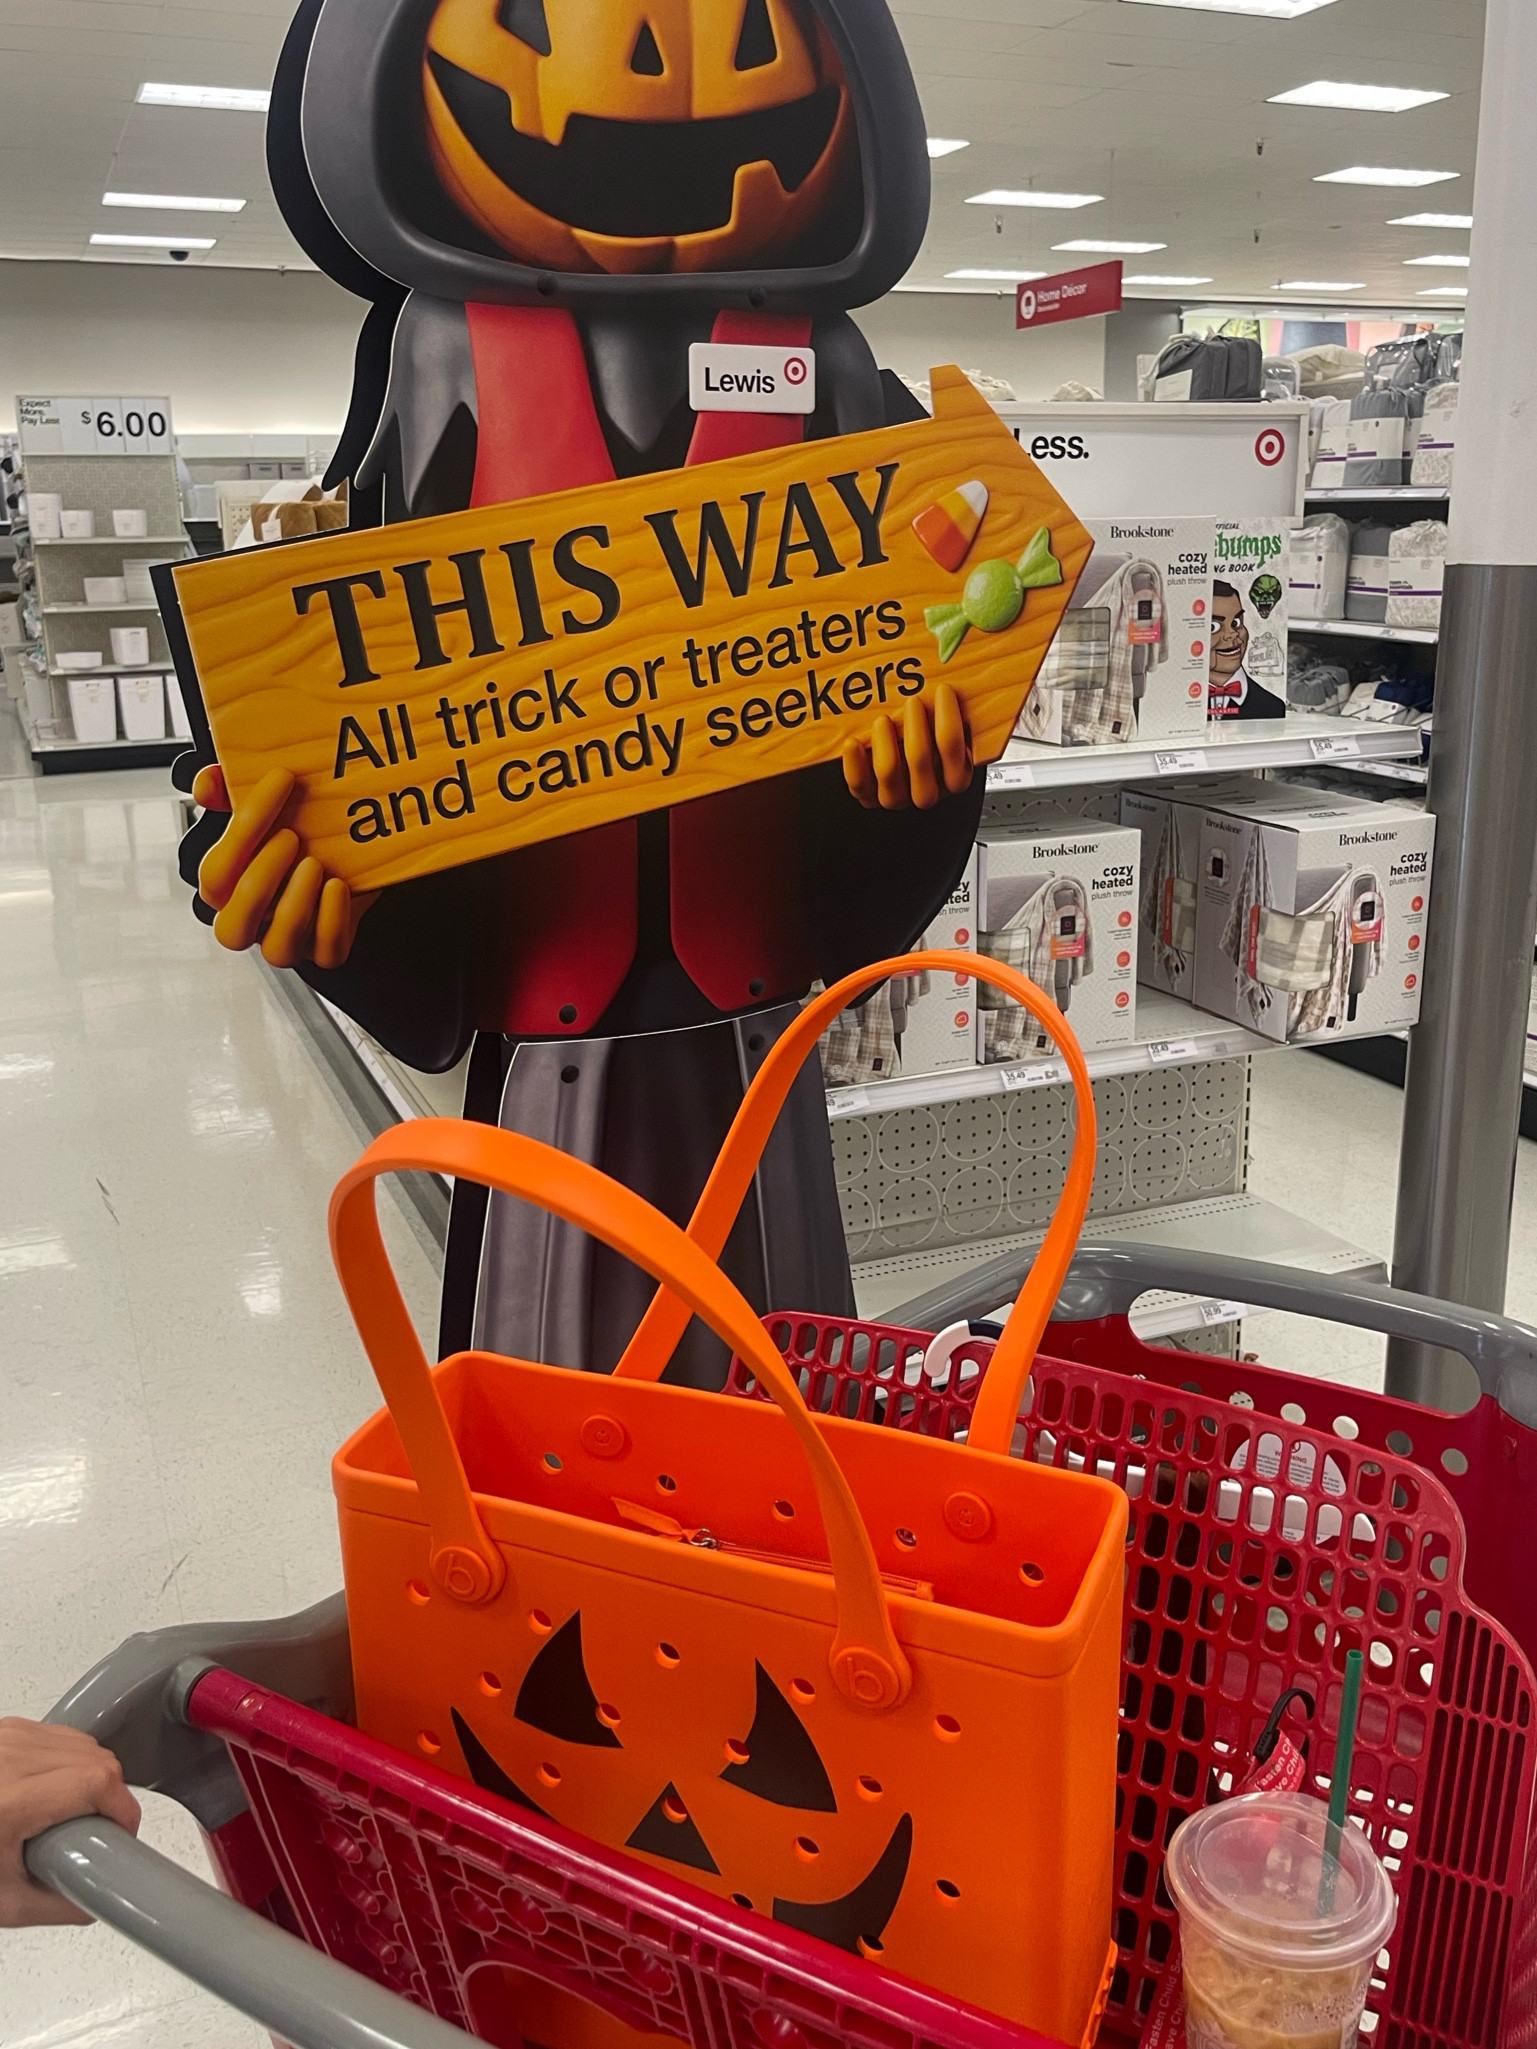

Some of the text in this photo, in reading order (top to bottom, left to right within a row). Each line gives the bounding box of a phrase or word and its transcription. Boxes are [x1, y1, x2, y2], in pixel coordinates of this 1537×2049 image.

[705, 366, 775, 394] Lewis
[1110, 525, 1175, 539] Brookstone
[1215, 531, 1282, 569] bumps
[1178, 552, 1208, 564] cozy
[291, 462, 901, 689] THIS WAY
[1168, 563, 1208, 575] heated
[1228, 563, 1256, 573] BOOK
[1167, 578, 1187, 586] plush
[333, 599, 908, 780] All trick or treaters
[346, 655, 927, 845] and candy seekers
[1125, 798, 1158, 813] Brookstone
[1205, 816, 1243, 835] Brookstone
[1339, 831, 1398, 847] Brookstone
[1032, 843, 1099, 859] Brookstone
[1400, 851, 1428, 864] cozy
[1103, 865, 1134, 877] cozy
[1390, 861, 1427, 877] heated
[954, 880, 970, 892] zy
[1092, 875, 1133, 890] heated
[1388, 875, 1427, 887] plush throw
[945, 892, 970, 905] ted
[1091, 889, 1134, 901] plush throw
[949, 906, 970, 914] throw
[1256, 1756, 1286, 1787] asten
[1159, 1976, 1177, 2008] Child
